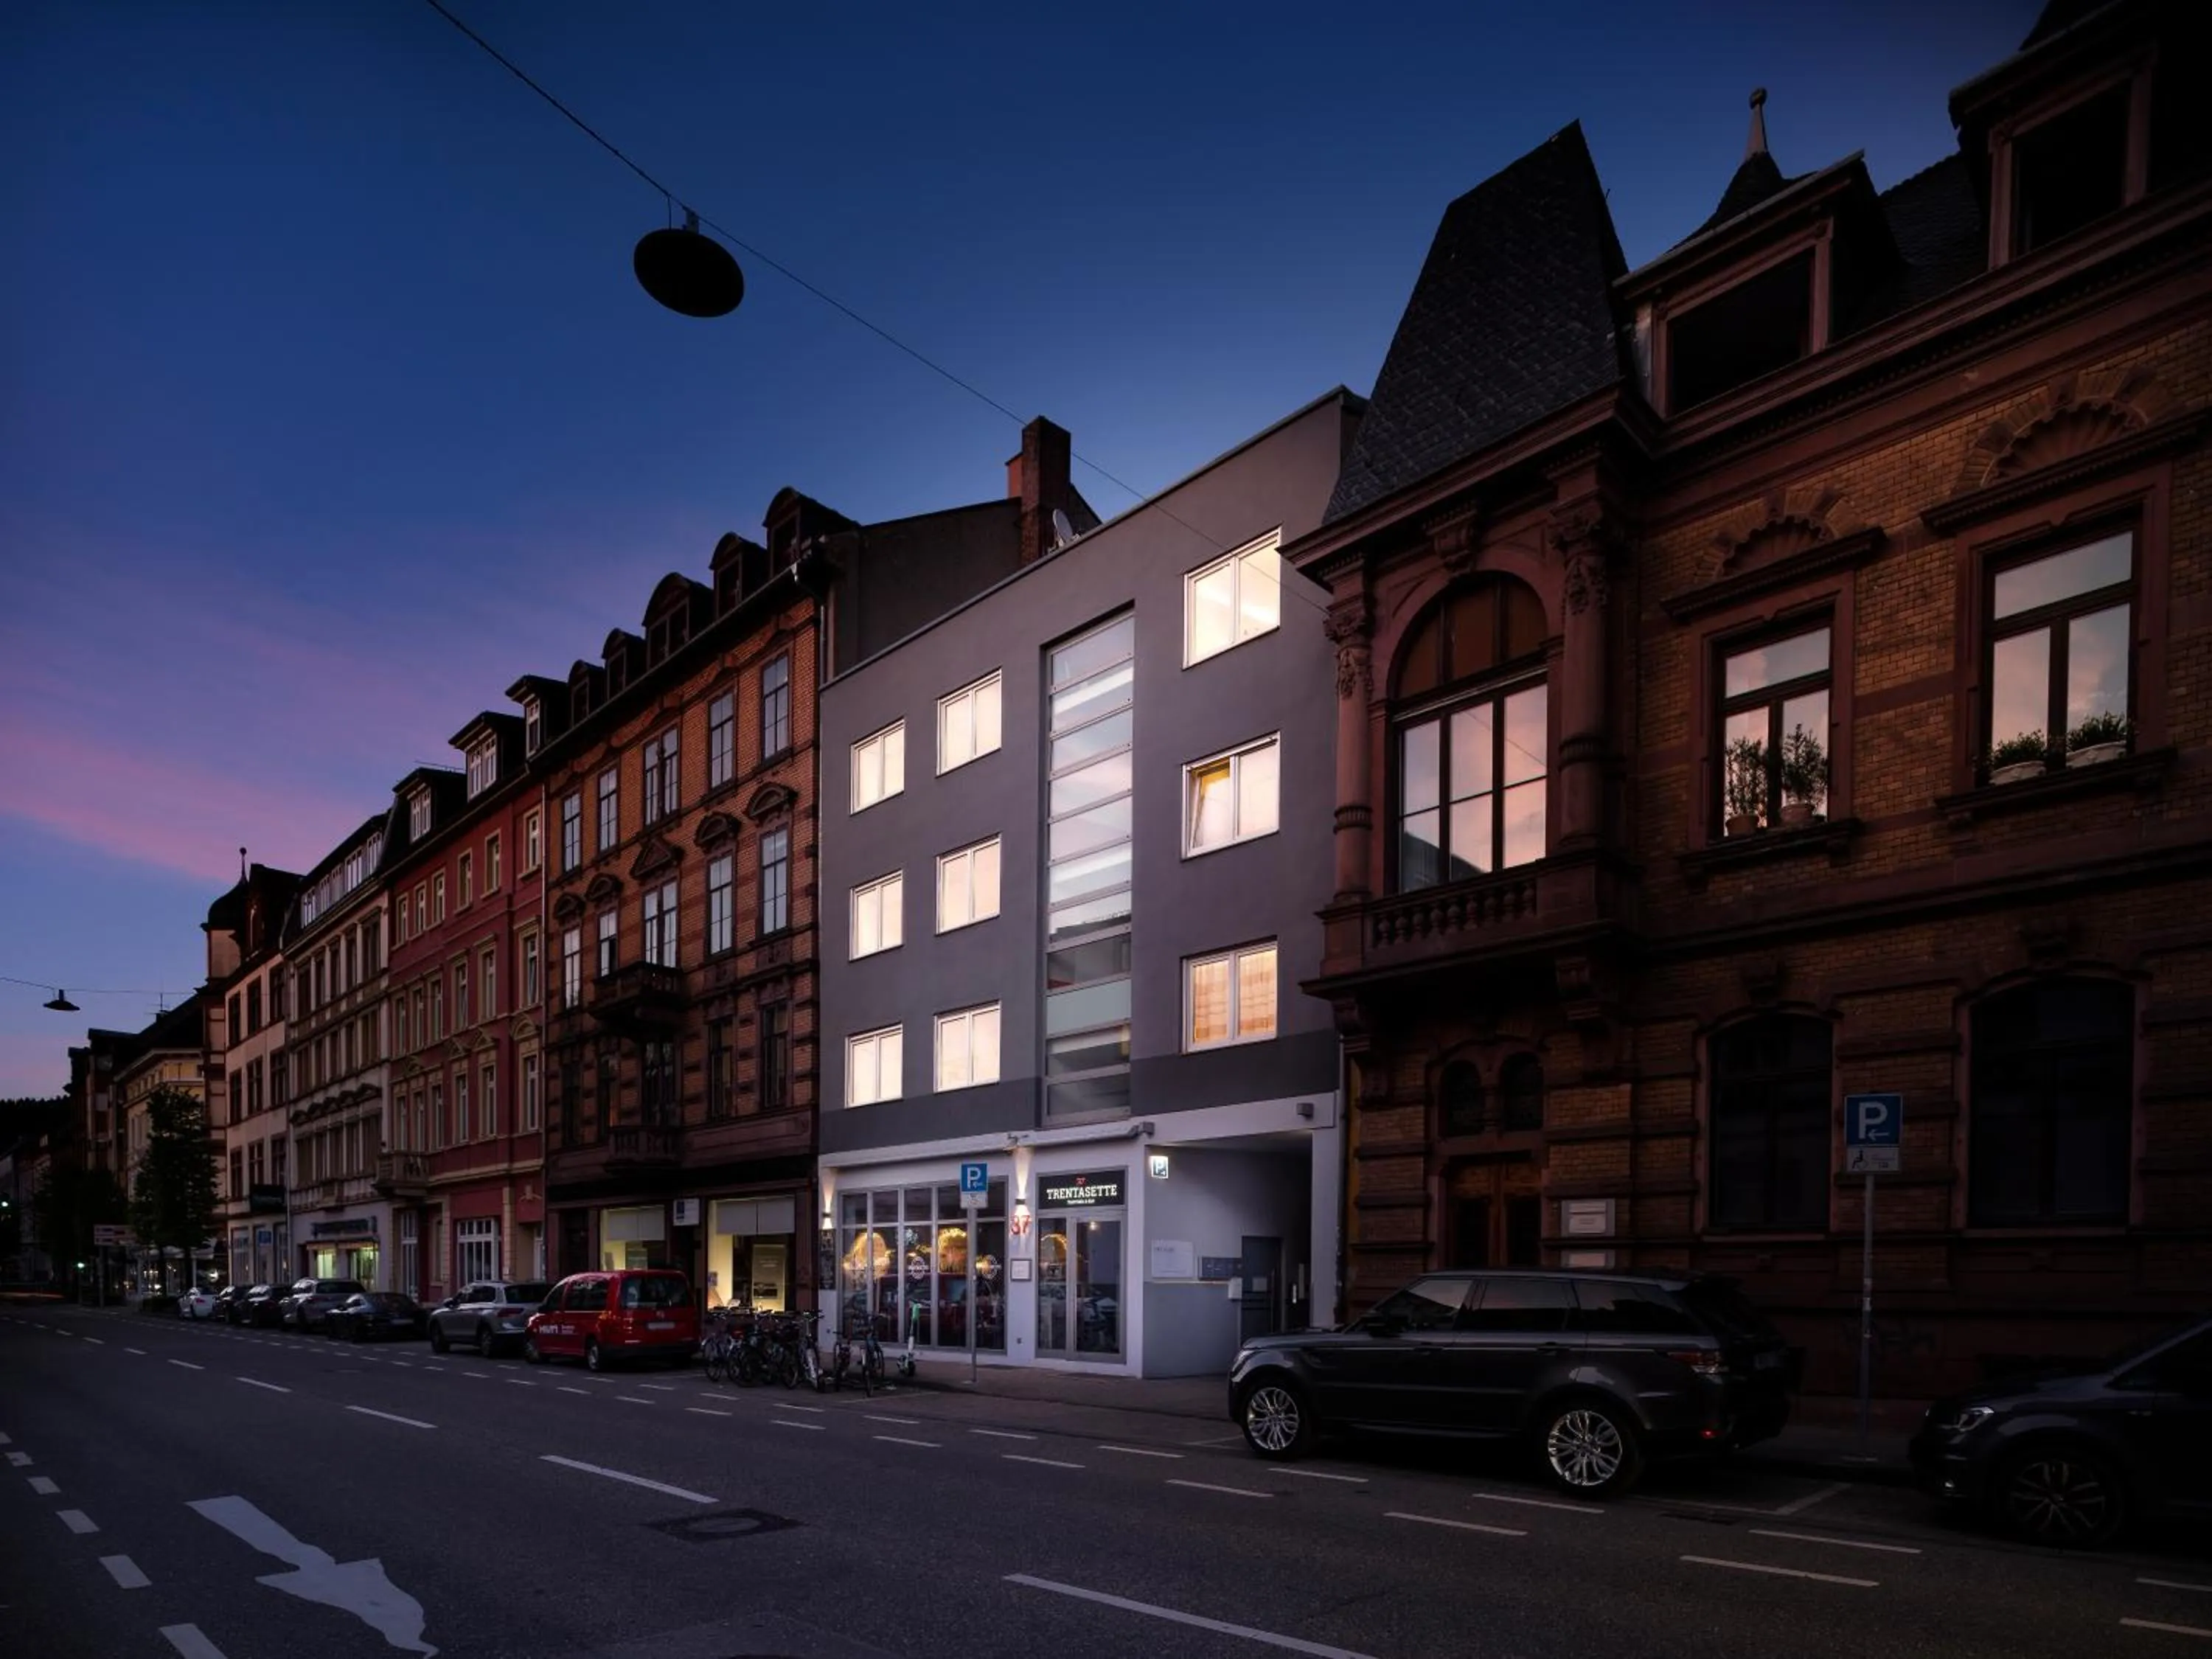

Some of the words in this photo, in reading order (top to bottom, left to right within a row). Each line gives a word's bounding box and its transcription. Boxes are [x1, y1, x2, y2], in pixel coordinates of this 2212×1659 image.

[1859, 1102, 1888, 1139] P
[967, 1167, 981, 1189] P
[1046, 1184, 1117, 1200] TRENTASETTE
